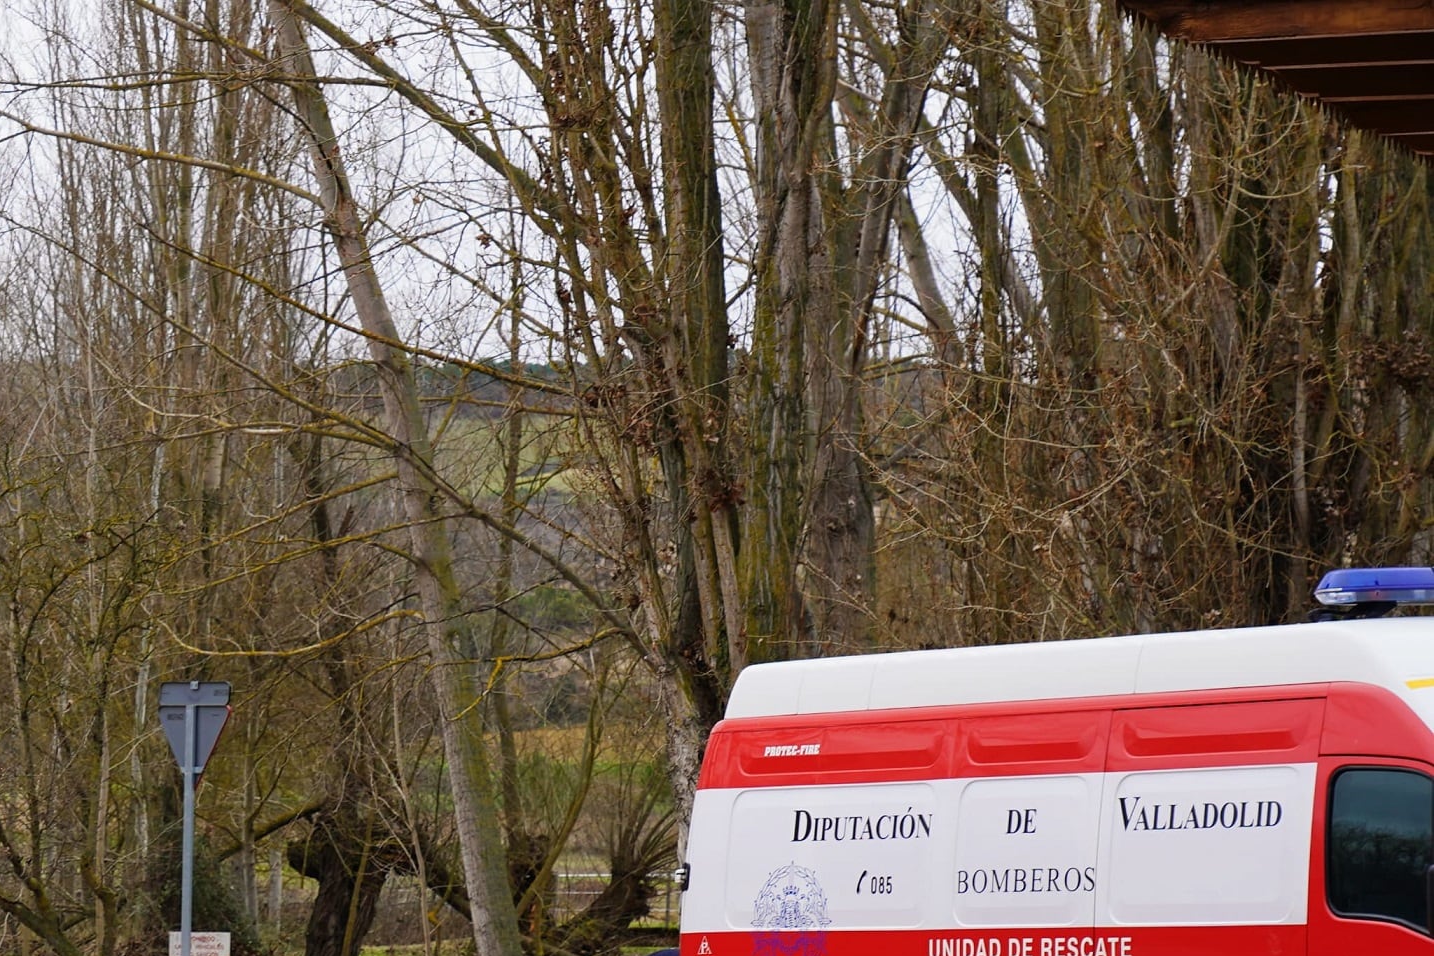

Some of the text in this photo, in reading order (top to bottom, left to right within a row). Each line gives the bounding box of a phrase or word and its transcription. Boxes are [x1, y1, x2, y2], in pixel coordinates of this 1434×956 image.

[764, 744, 821, 757] PROTEC-FIRE
[791, 796, 1283, 842] DIPUTACIÓN DE VALLADOLID
[870, 876, 893, 895] 085
[957, 867, 1096, 894] BOMBEROS
